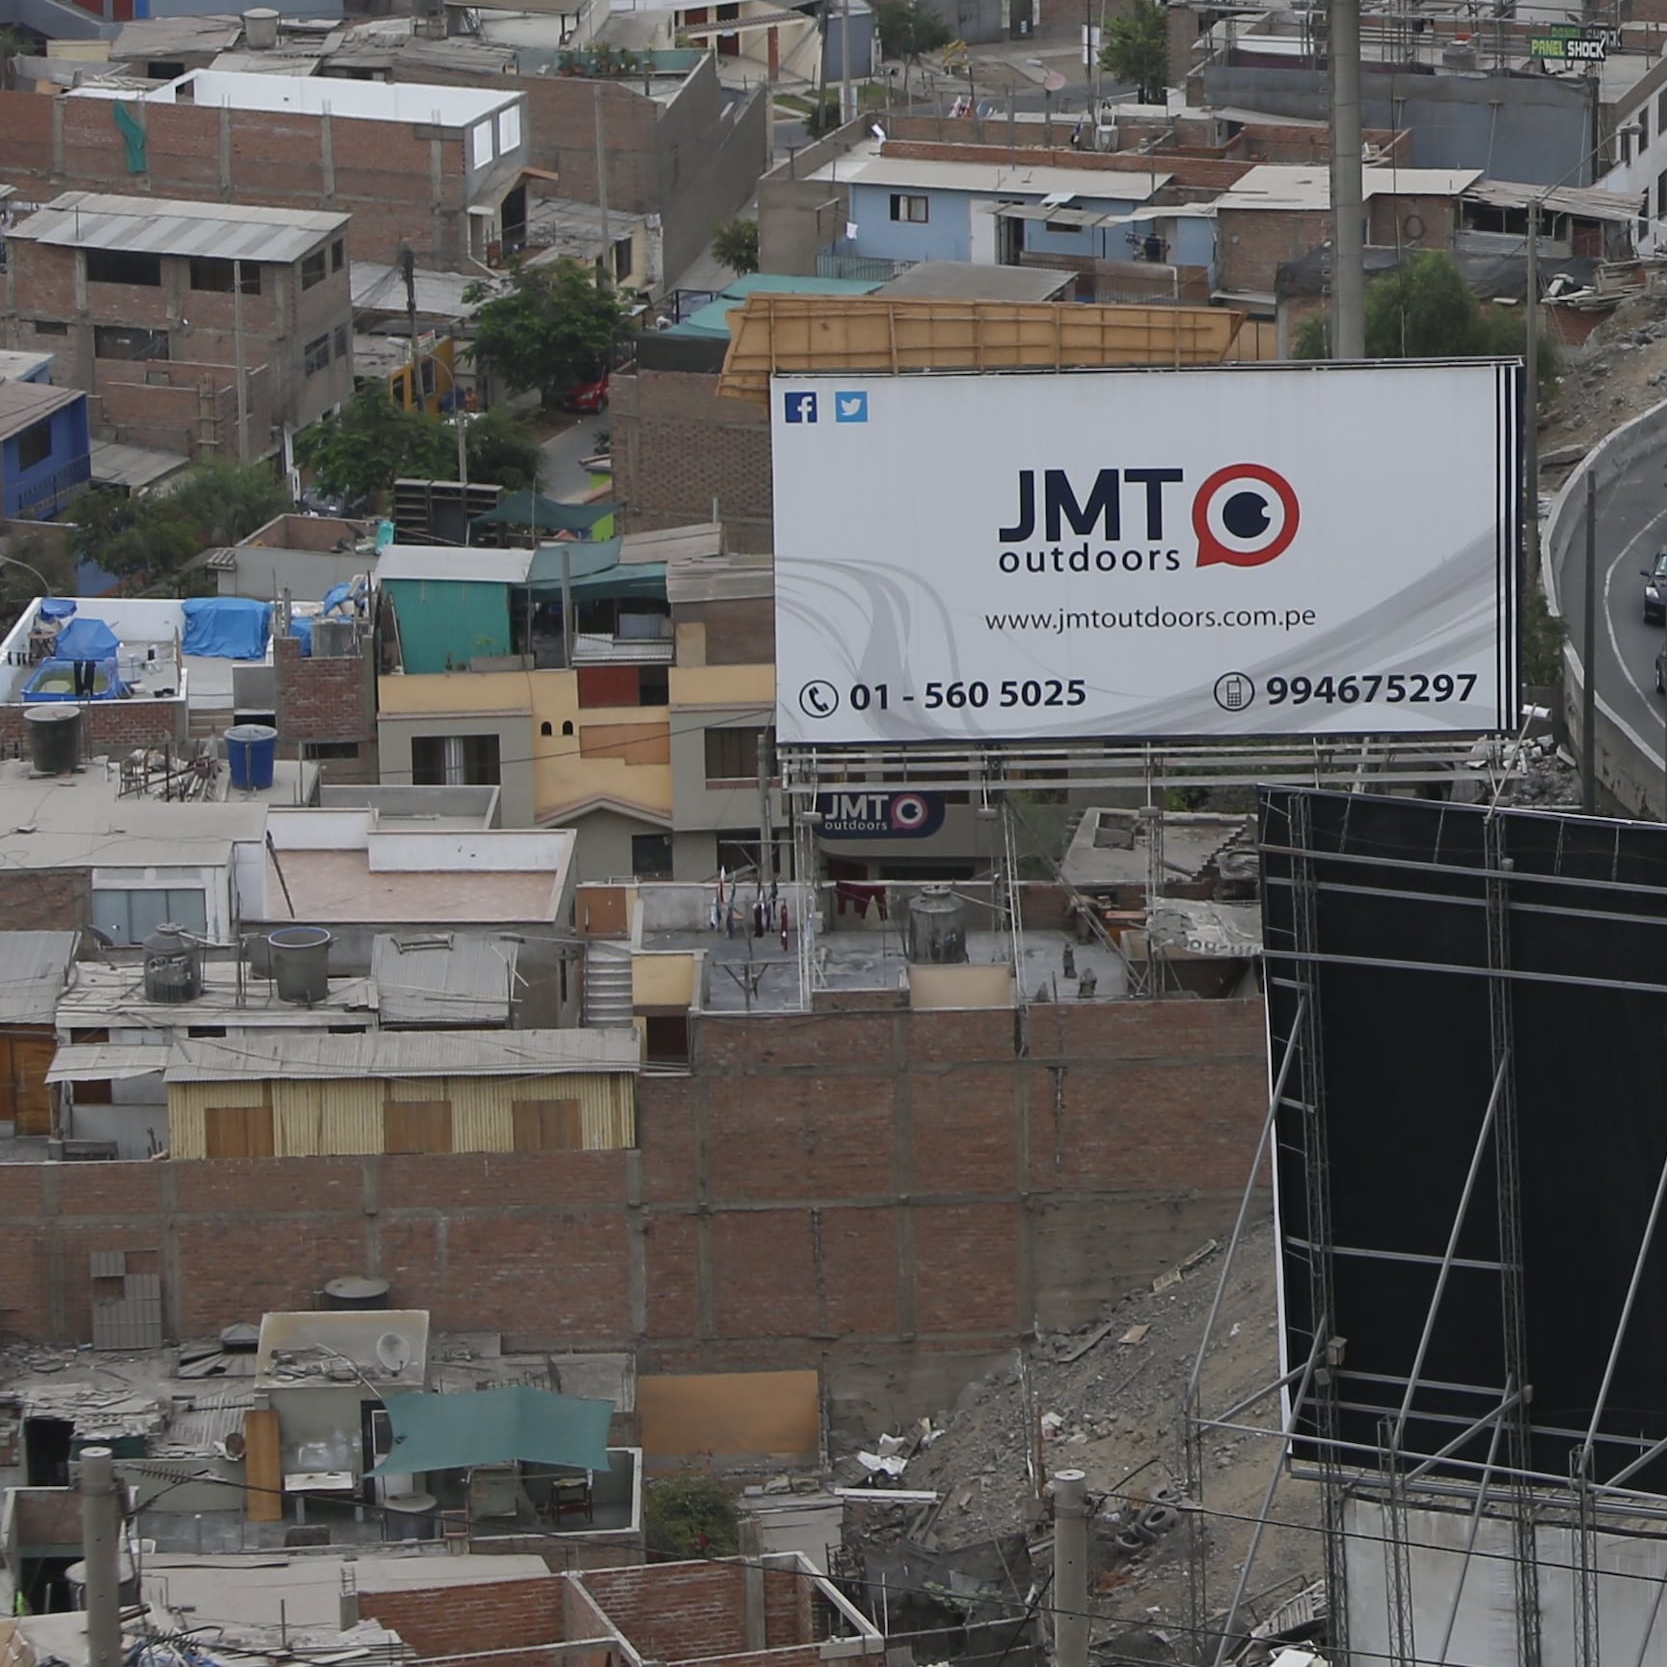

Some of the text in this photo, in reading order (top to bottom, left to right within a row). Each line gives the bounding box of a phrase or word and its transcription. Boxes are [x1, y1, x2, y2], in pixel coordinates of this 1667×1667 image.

[1531, 38, 1606, 59] PANEL SHOCK
[998, 468, 1184, 543] JMT
[998, 542, 1181, 574] outdoors
[984, 606, 1317, 635] www.jmtoutdoors.com.pe
[850, 683, 888, 711] 01
[924, 681, 989, 709] 560
[1000, 679, 1087, 708] 5025
[1266, 673, 1478, 706] 994675297
[825, 794, 889, 820] JMT
[824, 819, 888, 831] outdoors
